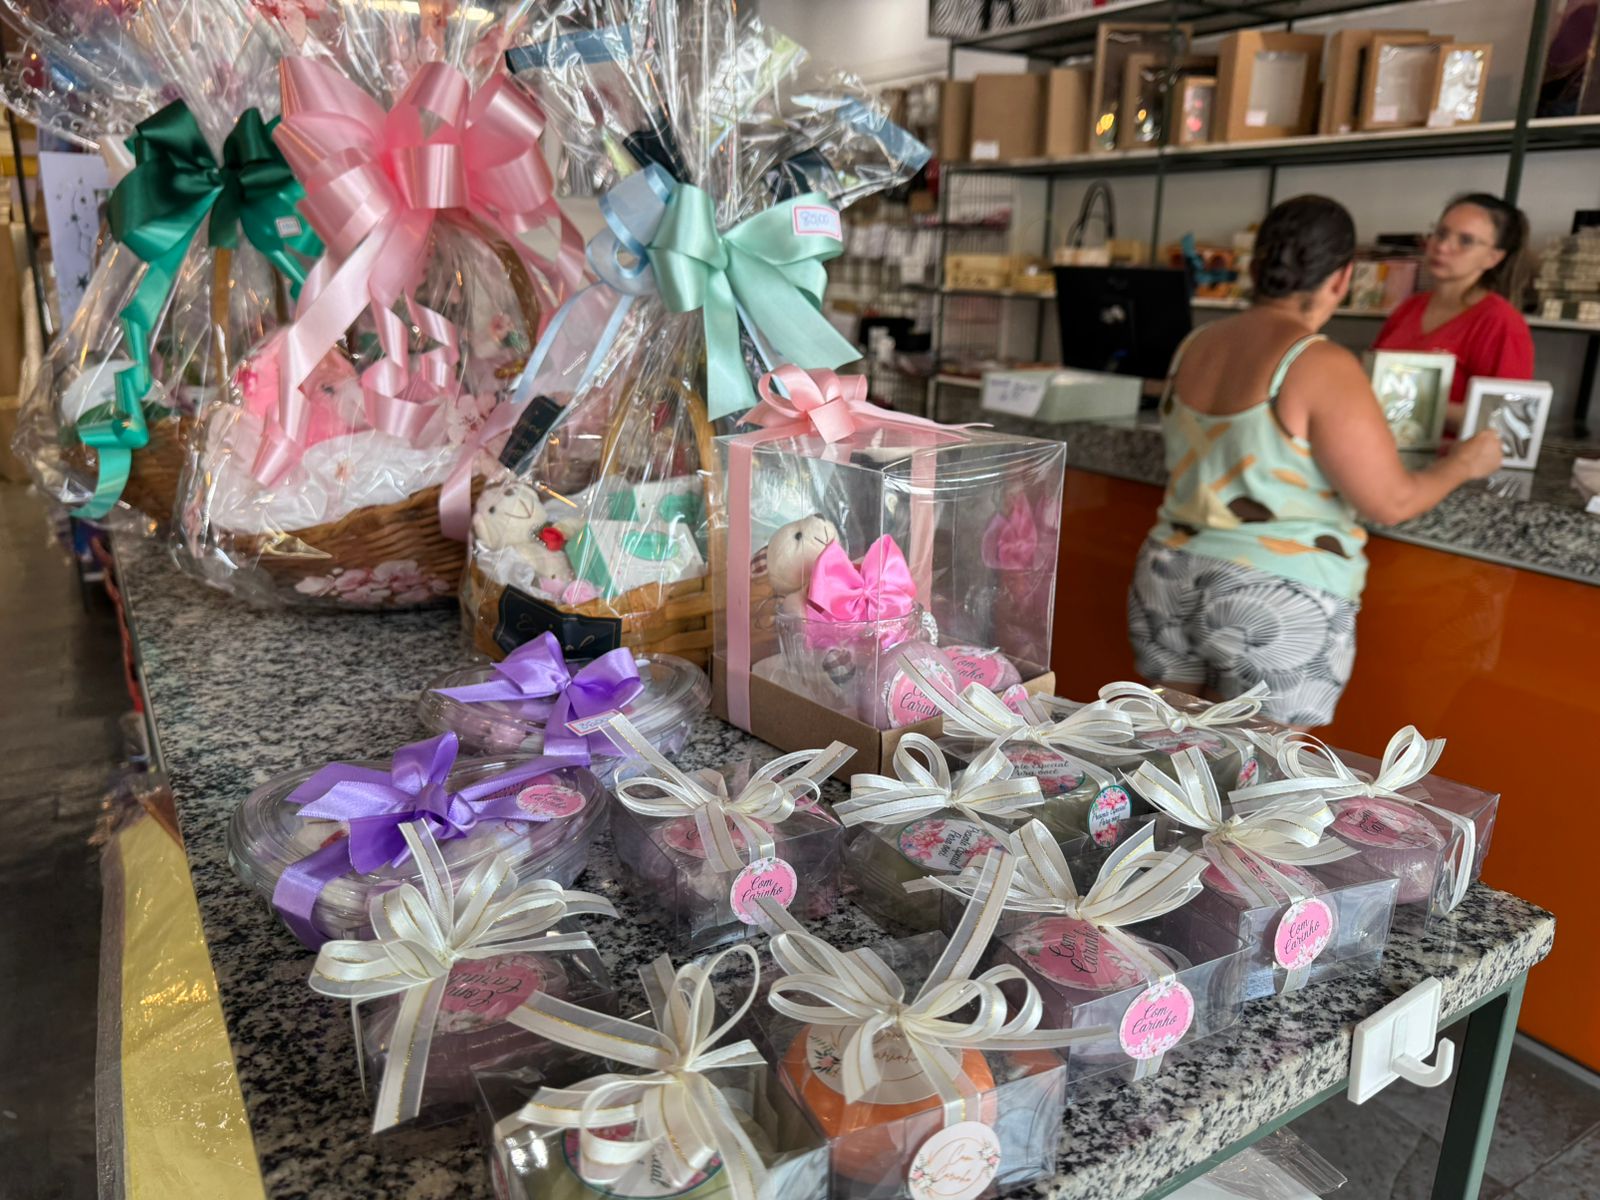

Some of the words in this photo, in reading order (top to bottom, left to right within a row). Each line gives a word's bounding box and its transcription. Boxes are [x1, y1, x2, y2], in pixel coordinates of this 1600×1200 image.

[957, 667, 985, 680] inho
[741, 882, 784, 902] Carinho
[751, 875, 774, 891] Com
[1284, 919, 1321, 955] Carinho
[1289, 919, 1309, 939] Com
[1048, 931, 1076, 958] Com
[447, 973, 522, 994] Carinh
[1143, 1002, 1169, 1019] Com
[1131, 1010, 1178, 1036] Carinho
